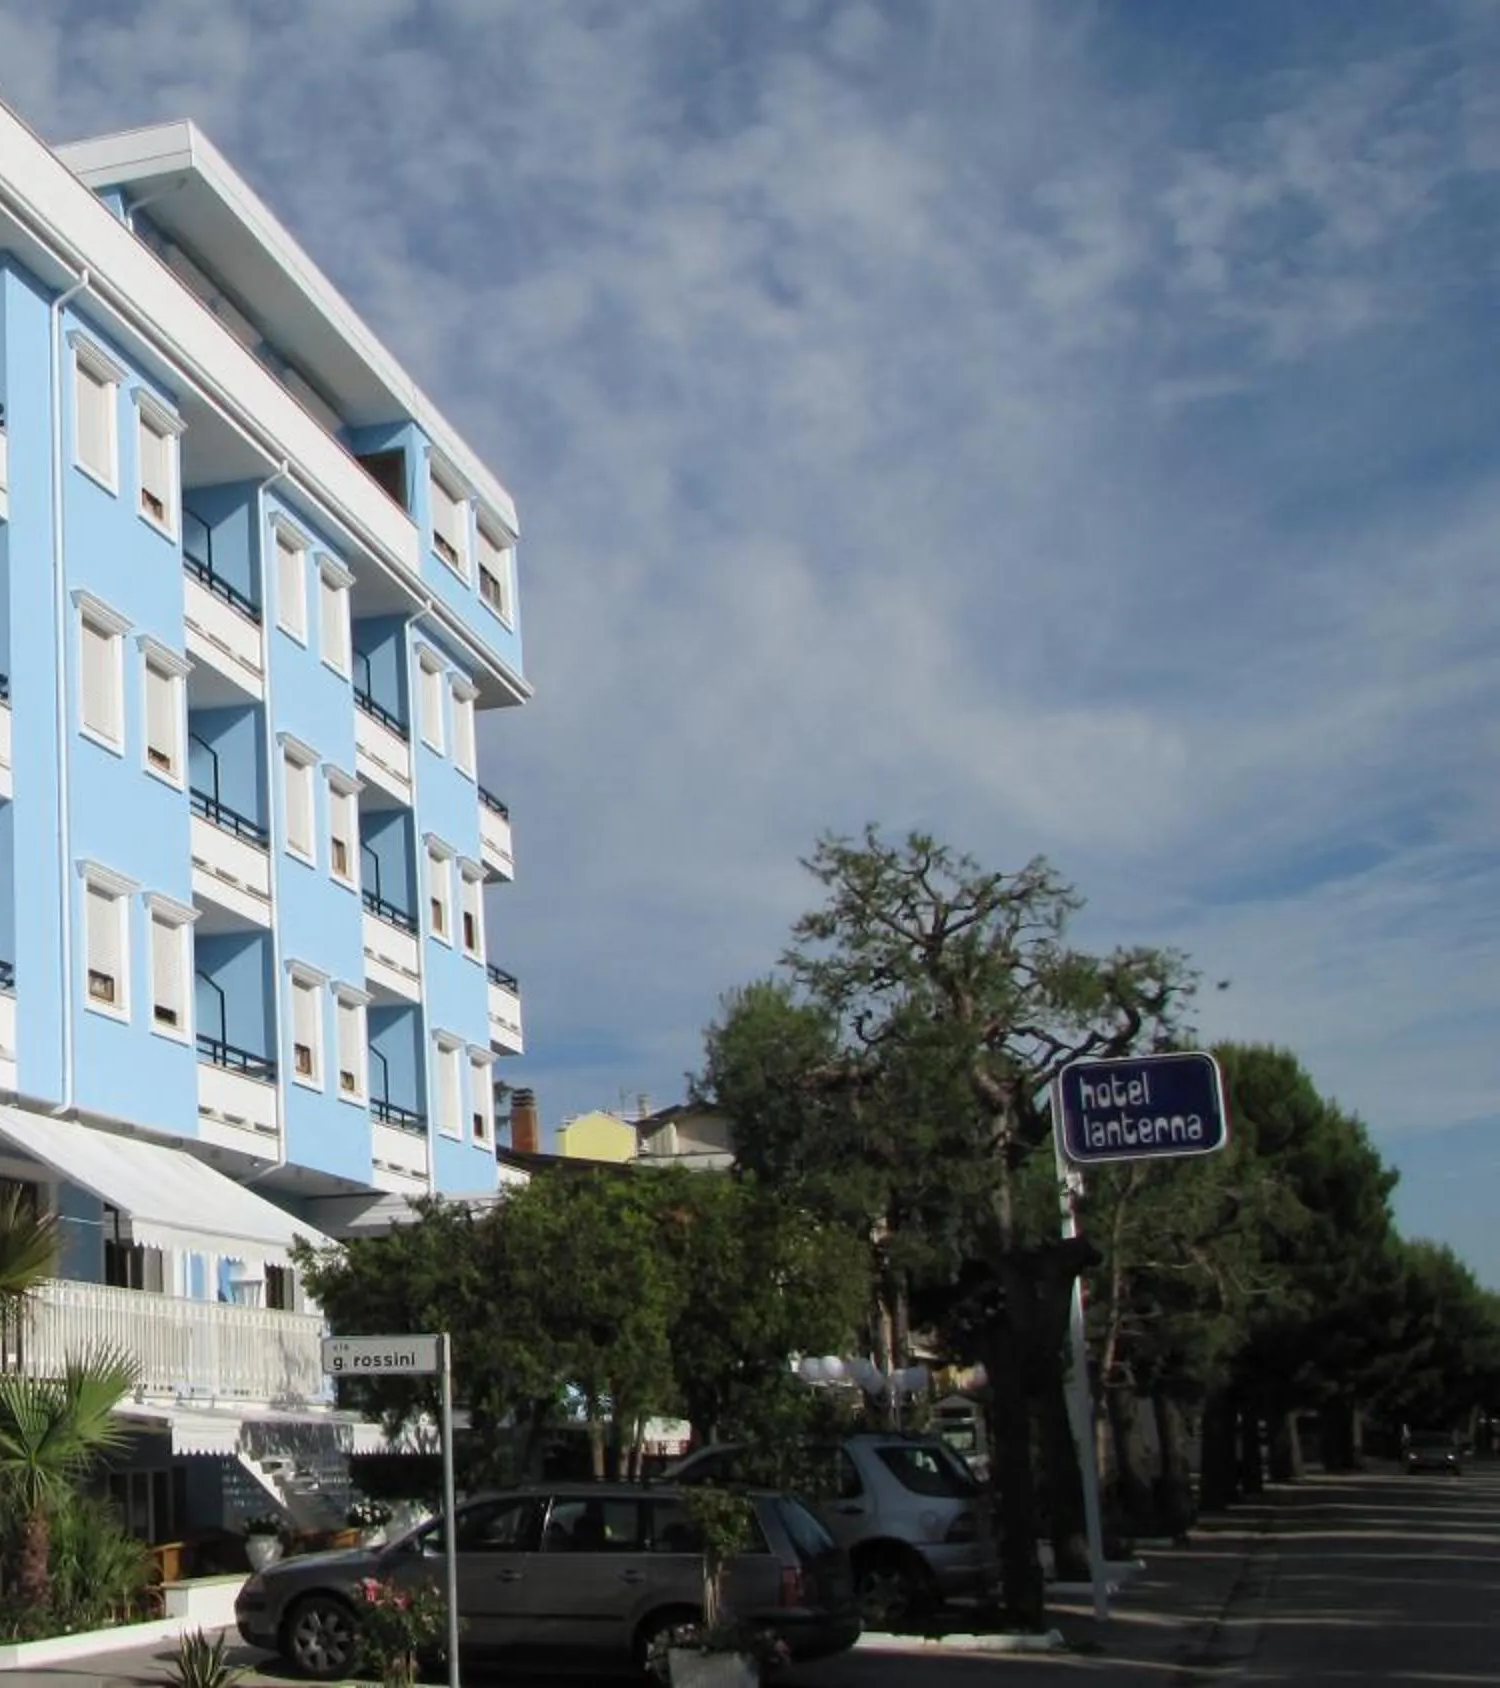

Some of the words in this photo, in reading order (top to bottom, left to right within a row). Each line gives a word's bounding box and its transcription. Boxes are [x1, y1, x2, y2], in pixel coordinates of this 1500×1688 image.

[1079, 1071, 1150, 1110] hotel
[1083, 1112, 1203, 1147] lanterna
[353, 1351, 415, 1366] rossini
